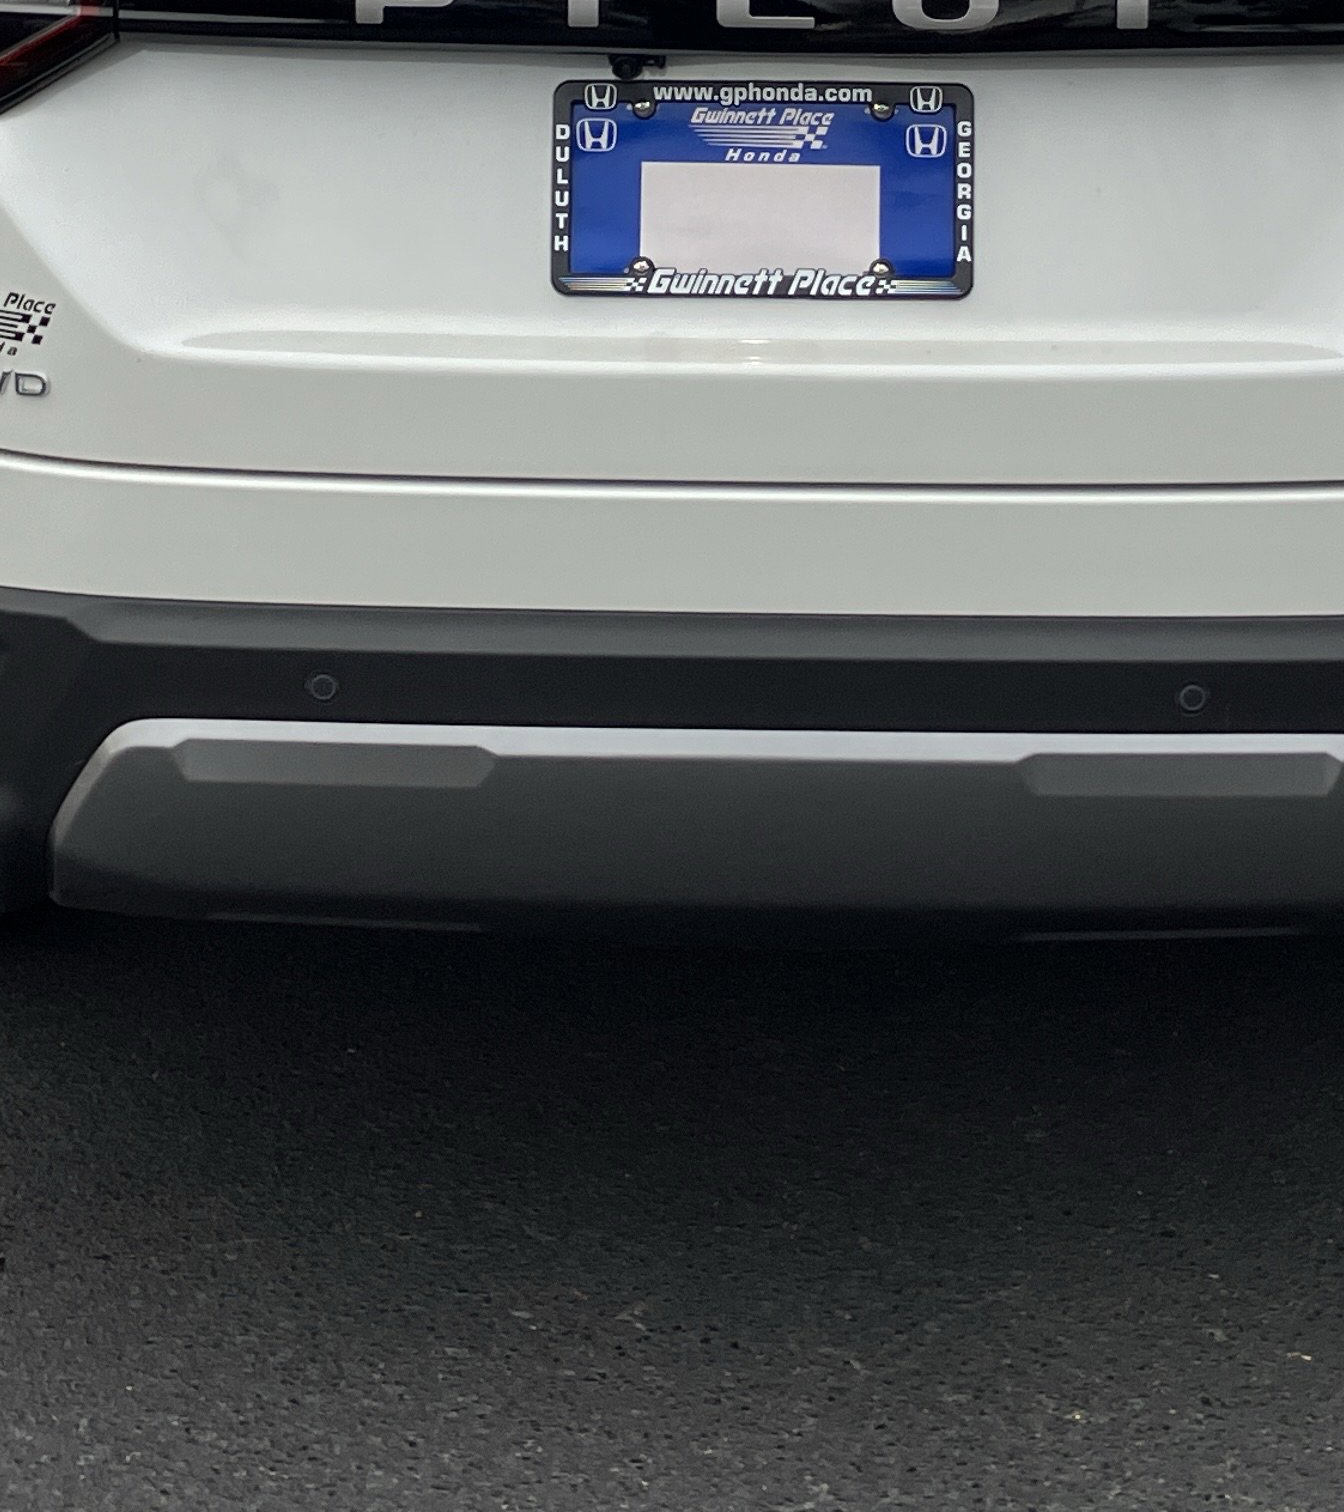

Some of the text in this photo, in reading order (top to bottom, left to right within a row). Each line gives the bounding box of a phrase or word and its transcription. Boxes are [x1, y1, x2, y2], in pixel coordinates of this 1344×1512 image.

[653, 84, 873, 105] www.gphonda.com
[690, 107, 835, 126] Gwinnett Place
[725, 148, 801, 163] Honda
[554, 124, 569, 252] DULUTH
[956, 120, 973, 262] GEORGIA
[647, 267, 876, 297] Gwinnett Place
[3, 292, 56, 315] Place
